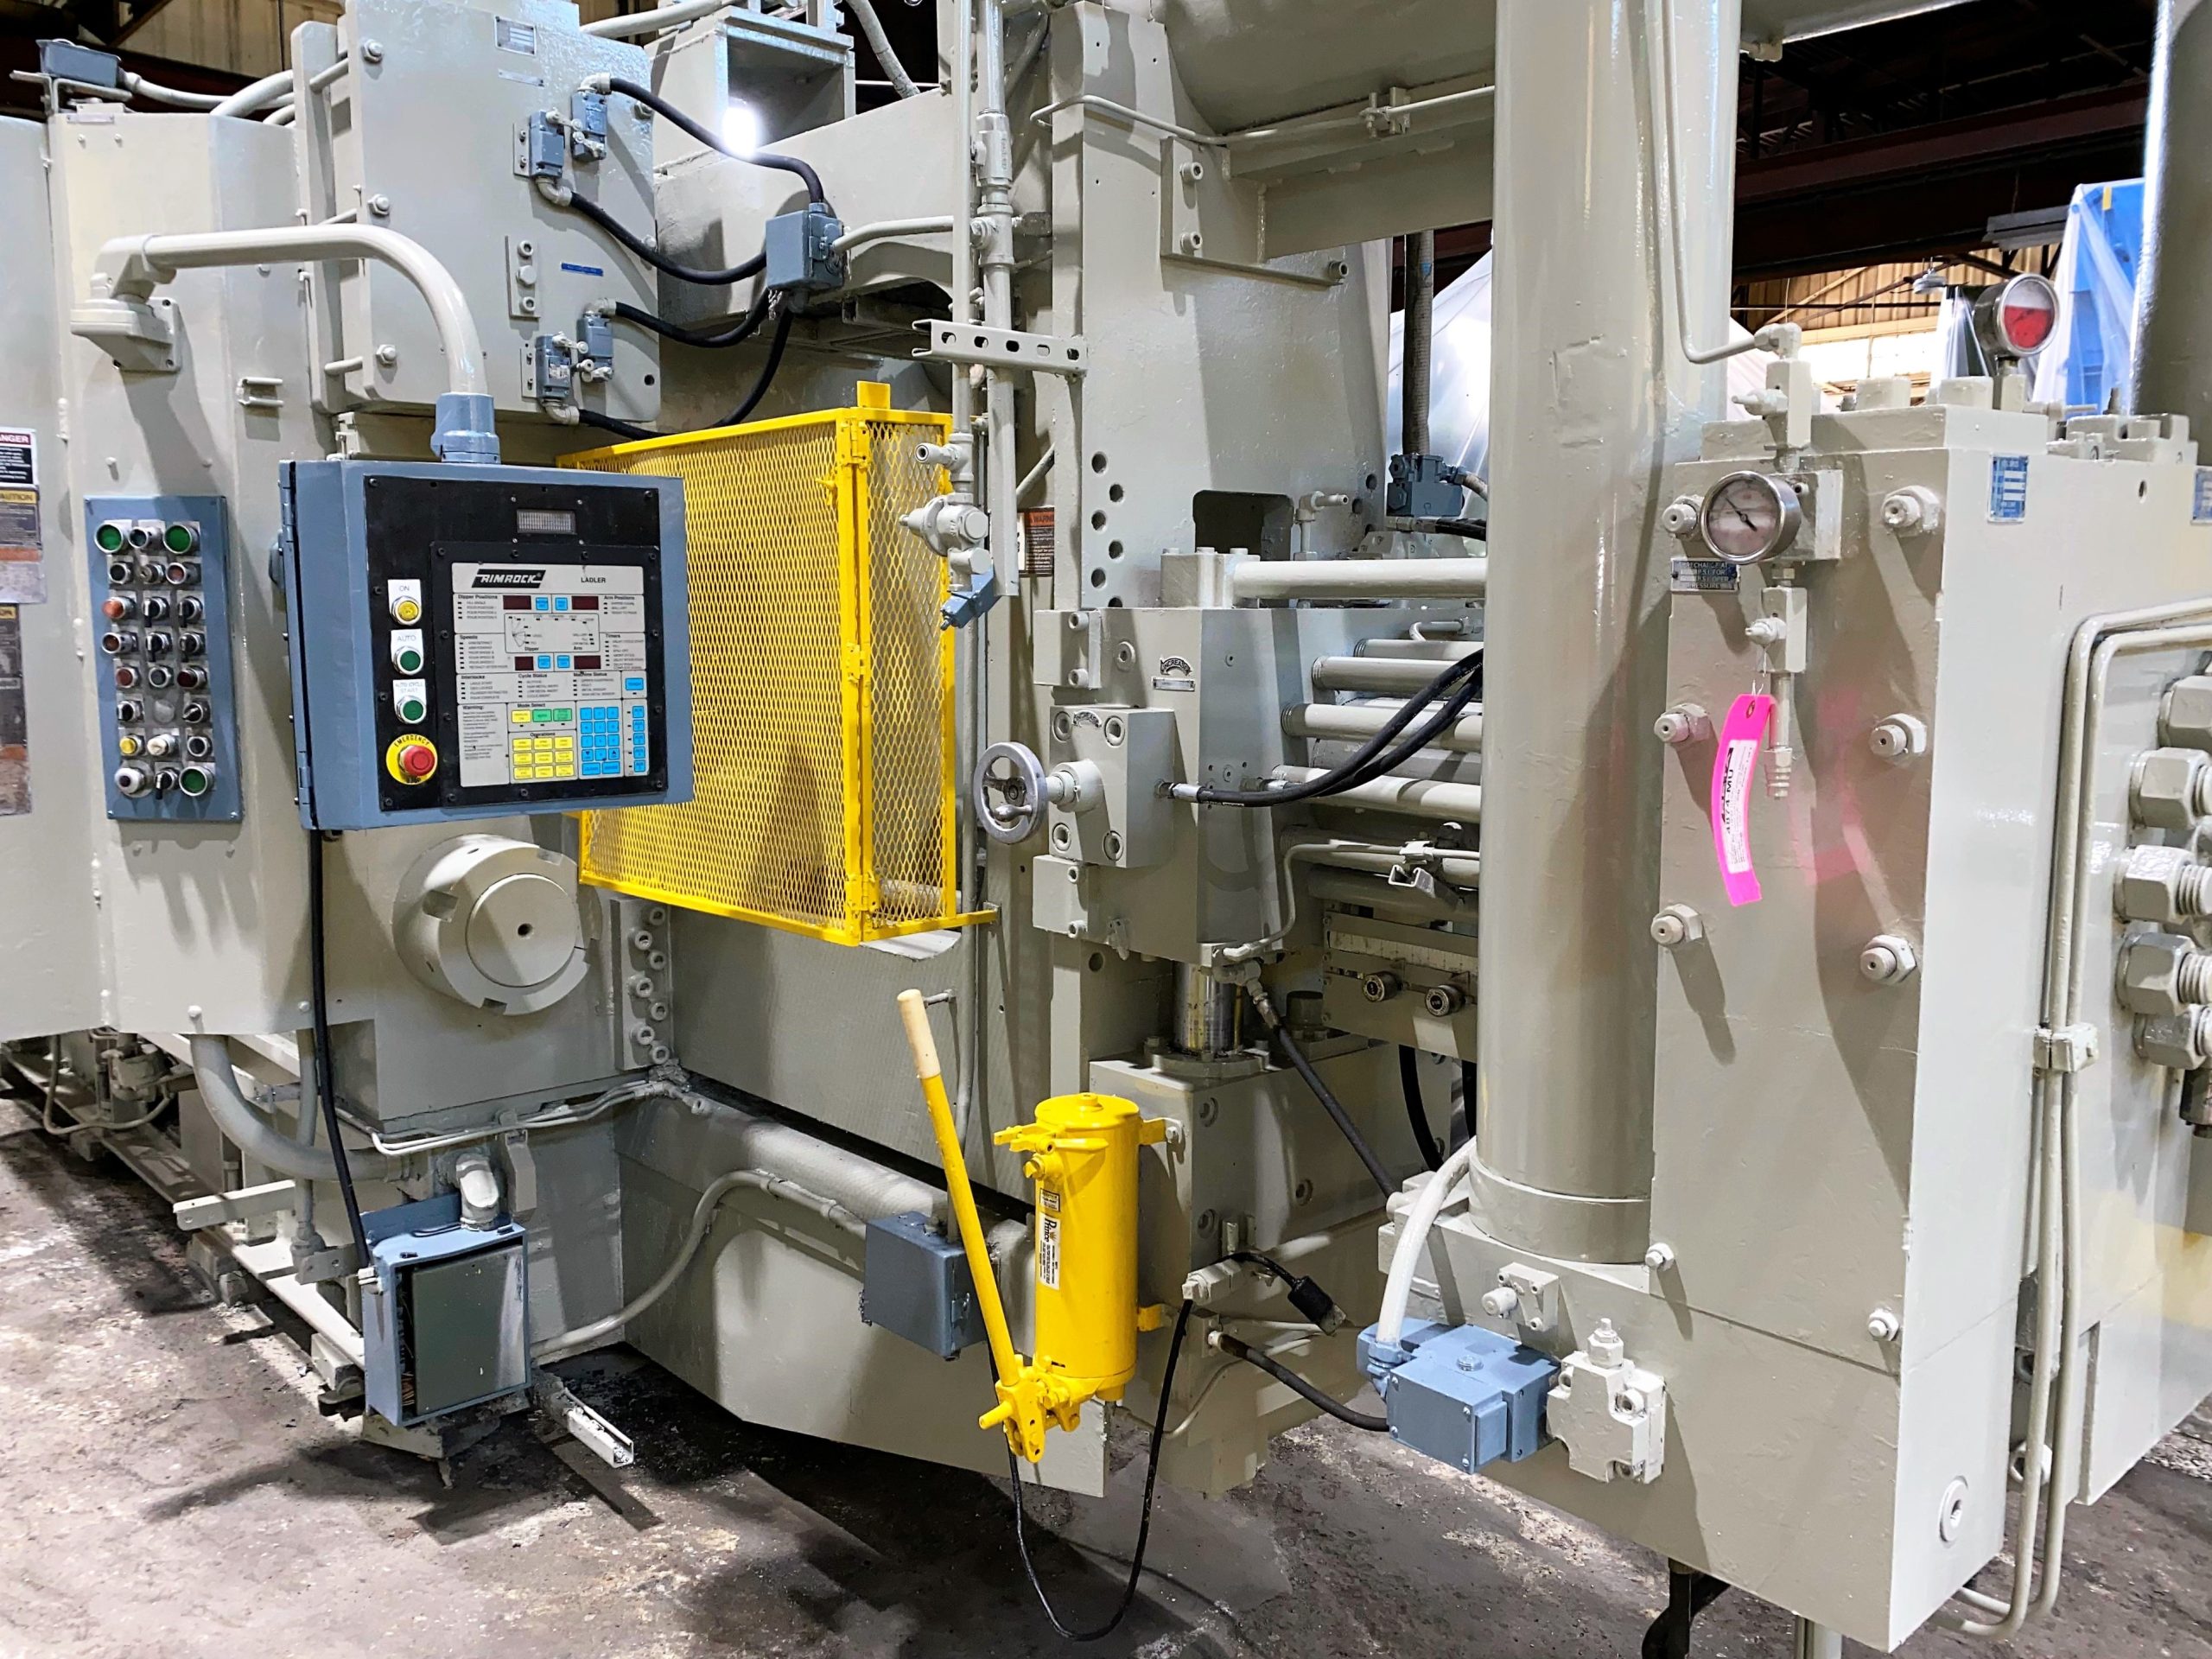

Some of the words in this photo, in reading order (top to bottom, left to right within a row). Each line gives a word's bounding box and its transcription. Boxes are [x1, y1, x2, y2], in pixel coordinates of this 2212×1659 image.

[0, 435, 29, 443] NGER
[1, 492, 33, 501] AUTION
[394, 734, 429, 747] EMERGENCY
[1044, 1218, 1057, 1243] Prince
